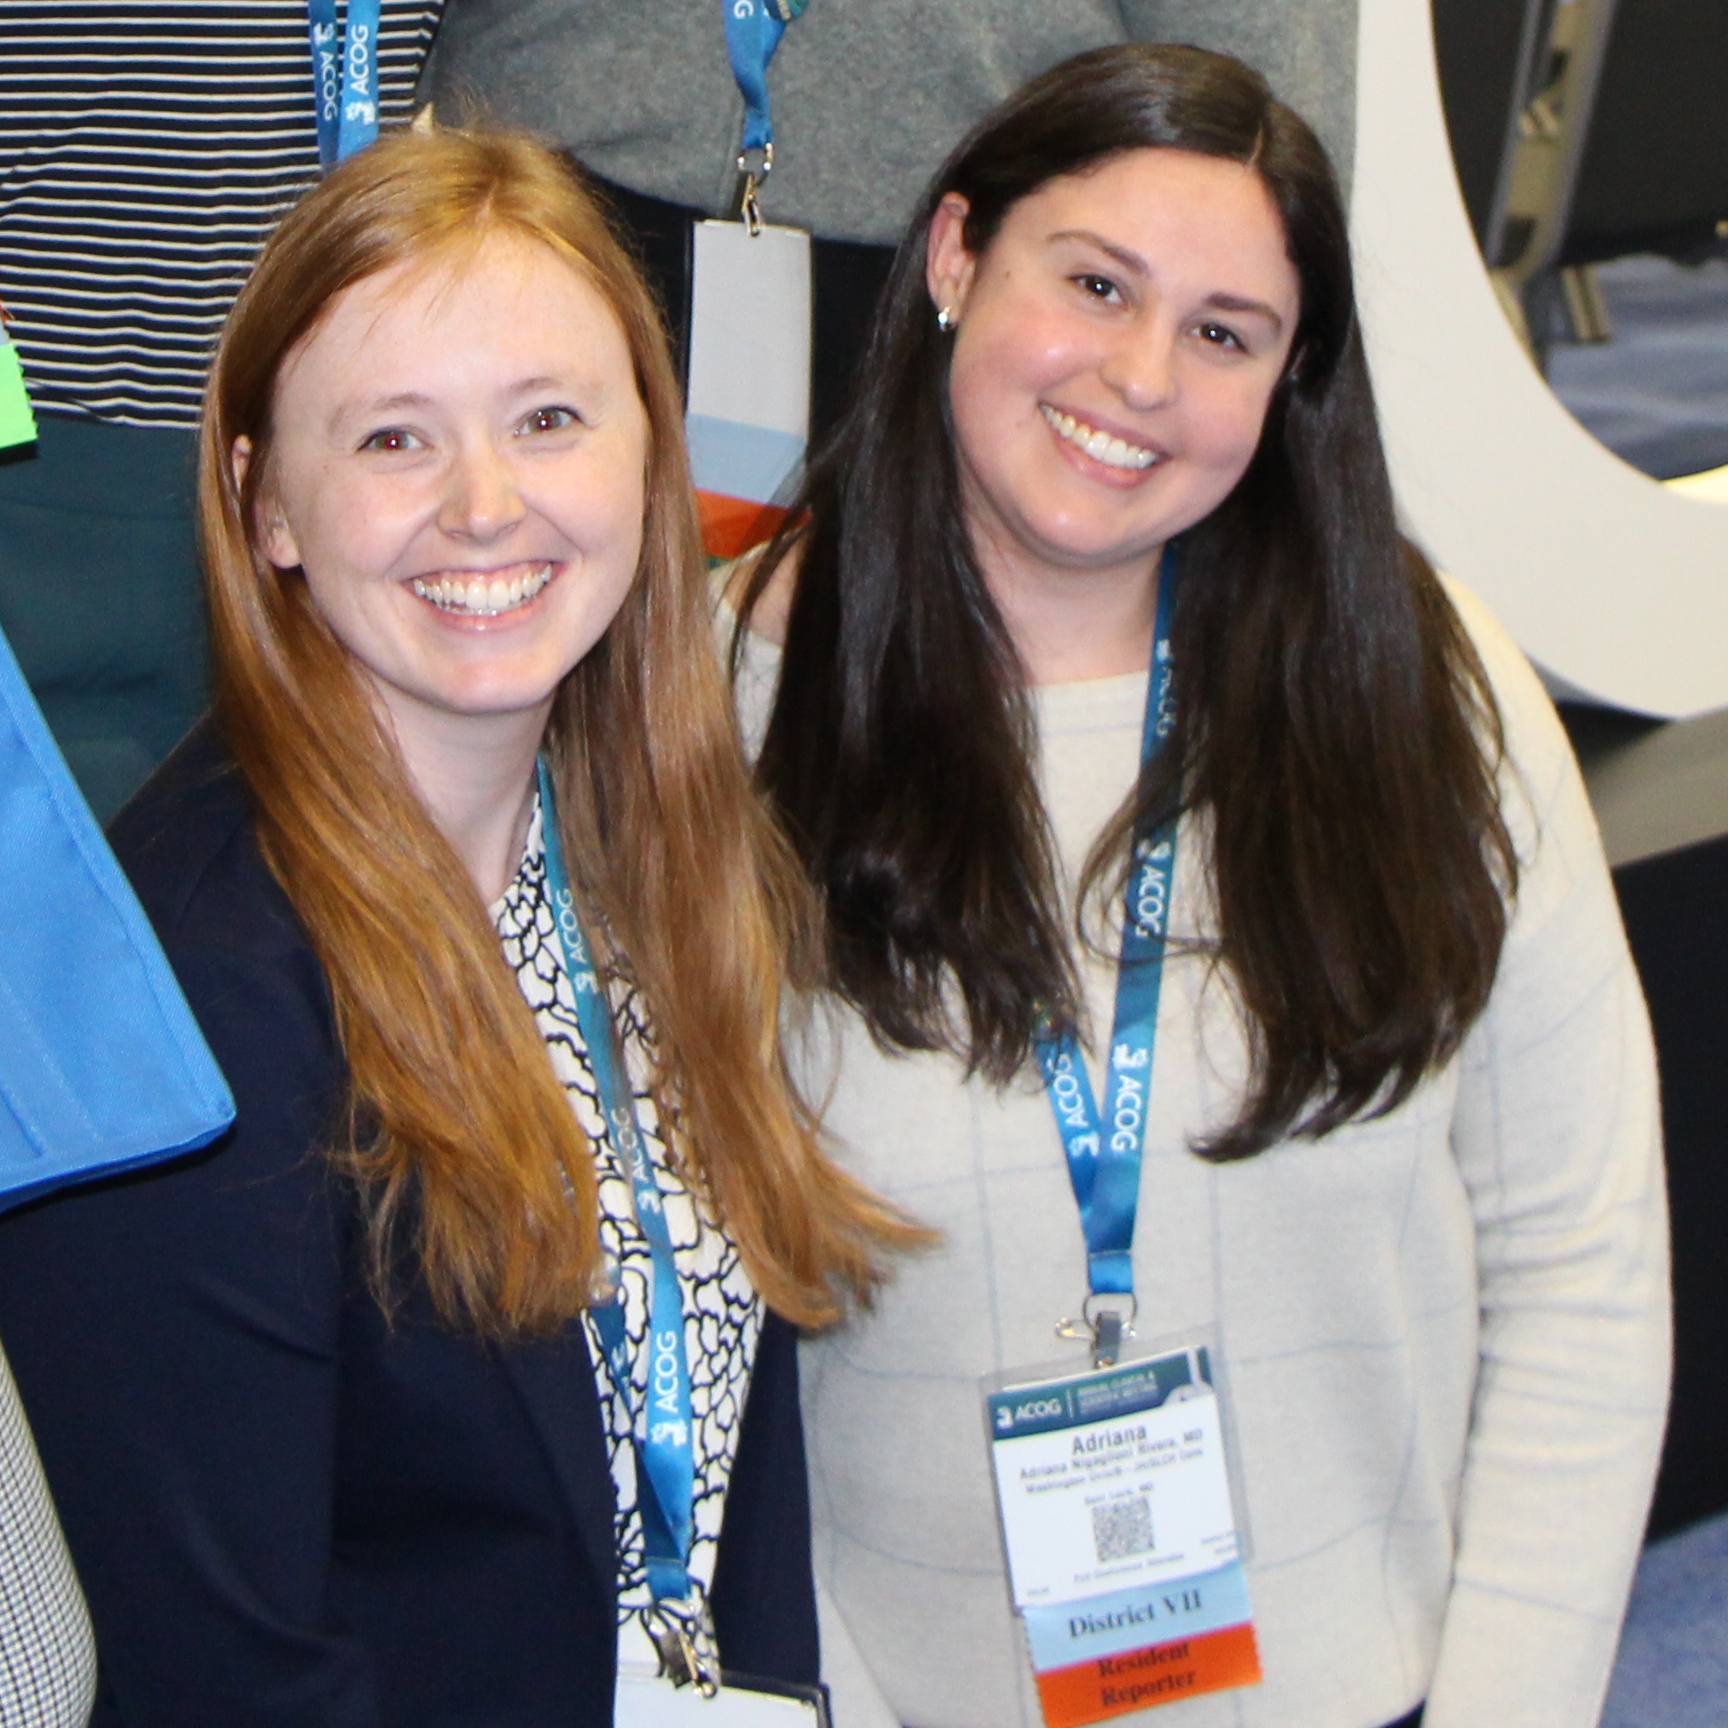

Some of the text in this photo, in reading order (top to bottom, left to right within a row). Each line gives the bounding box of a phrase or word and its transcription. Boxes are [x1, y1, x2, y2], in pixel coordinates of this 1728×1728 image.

[319, 51, 339, 122] ACOG
[350, 24, 370, 95] ACOG
[556, 887, 587, 965] ACOG
[1135, 863, 1165, 940] ACOG
[1046, 1052, 1090, 1129] ACOG
[1110, 1075, 1143, 1152] ACOG
[654, 1329, 680, 1413] ACOG
[1014, 1398, 1063, 1421] ACOG
[1072, 1424, 1149, 1456] Adriana
[1068, 1588, 1203, 1639] District VII
[1096, 1641, 1191, 1678] Resident
[1100, 1671, 1198, 1707] Reporter
